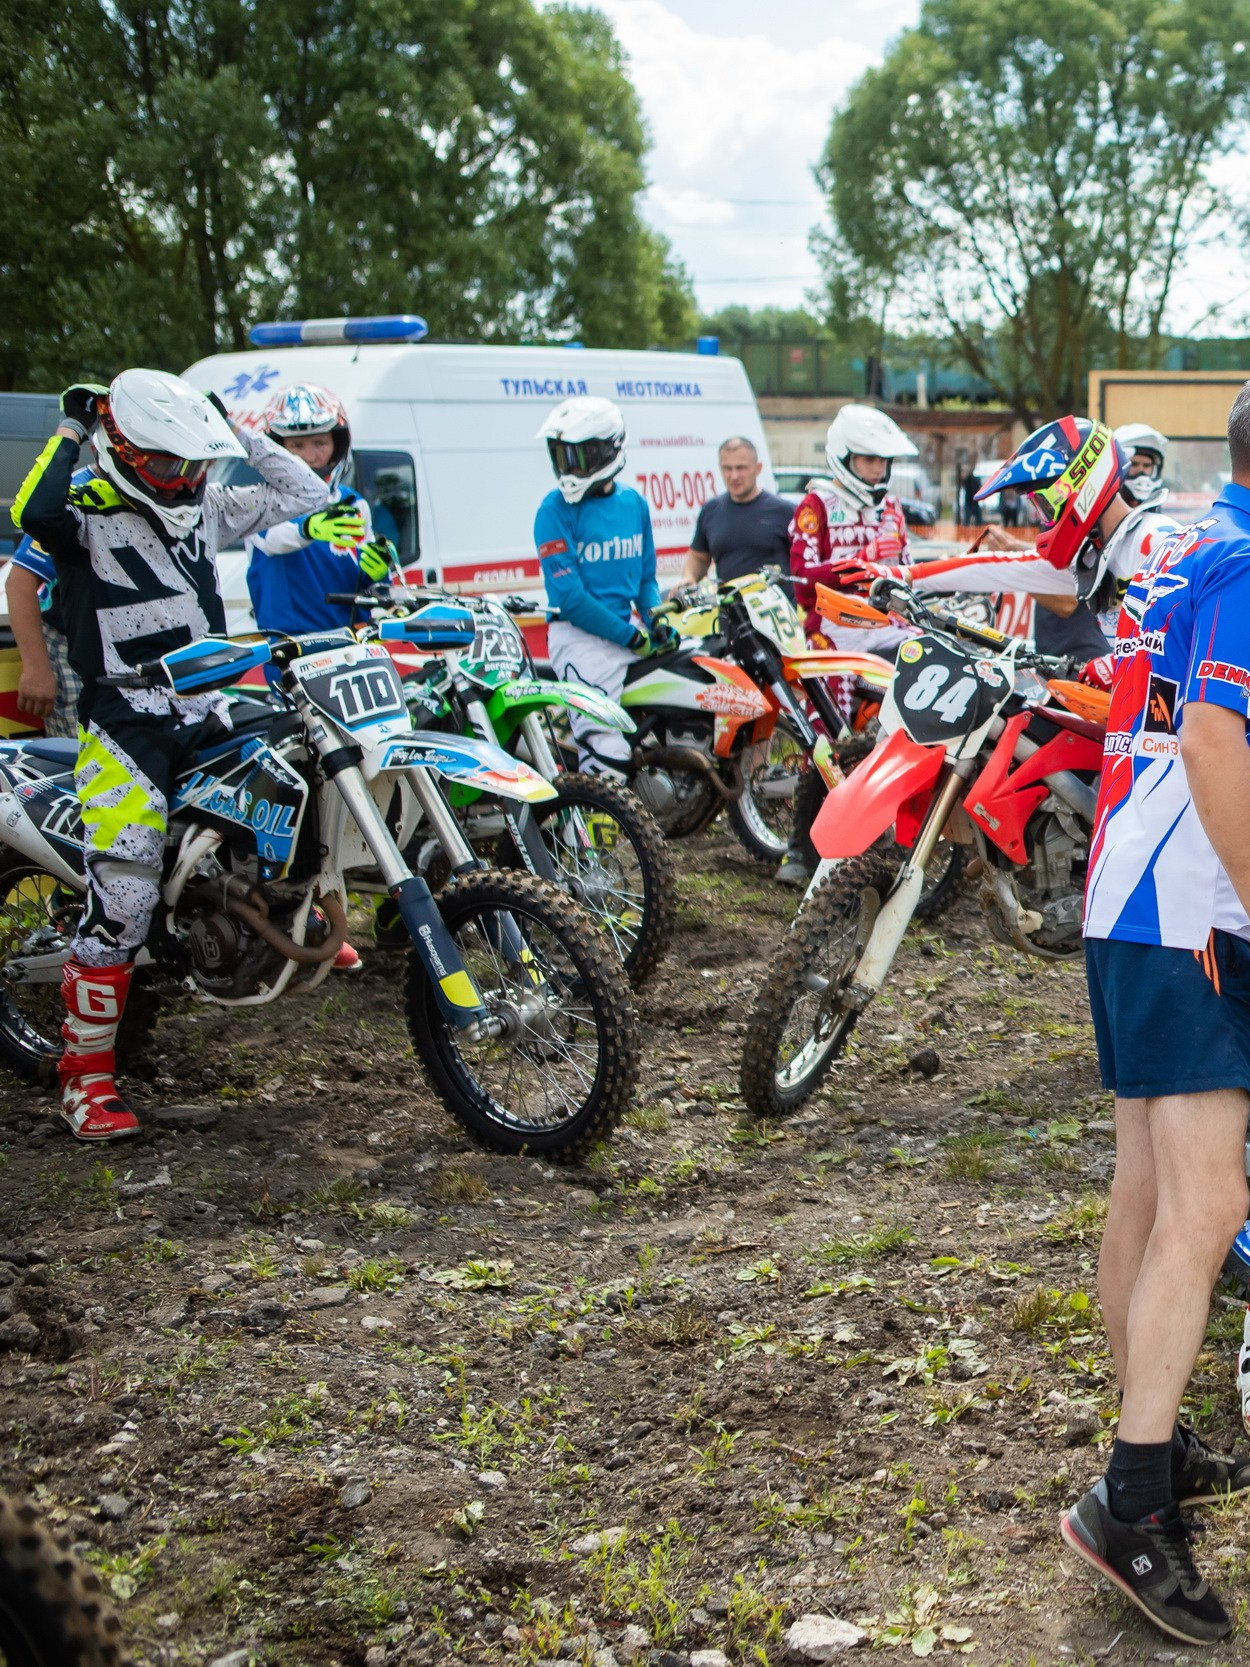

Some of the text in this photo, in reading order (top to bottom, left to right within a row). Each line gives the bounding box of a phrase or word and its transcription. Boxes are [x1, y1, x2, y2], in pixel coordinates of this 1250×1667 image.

[500, 379, 702, 397] ТУЛЬСКАЯ НЕОТЛОЖКА
[1069, 428, 1110, 487] SCOT
[637, 471, 717, 509] 700-003
[329, 666, 402, 724] 110
[903, 664, 978, 724] 84
[1142, 737, 1179, 756] СинЗ
[251, 798, 297, 838] OIL
